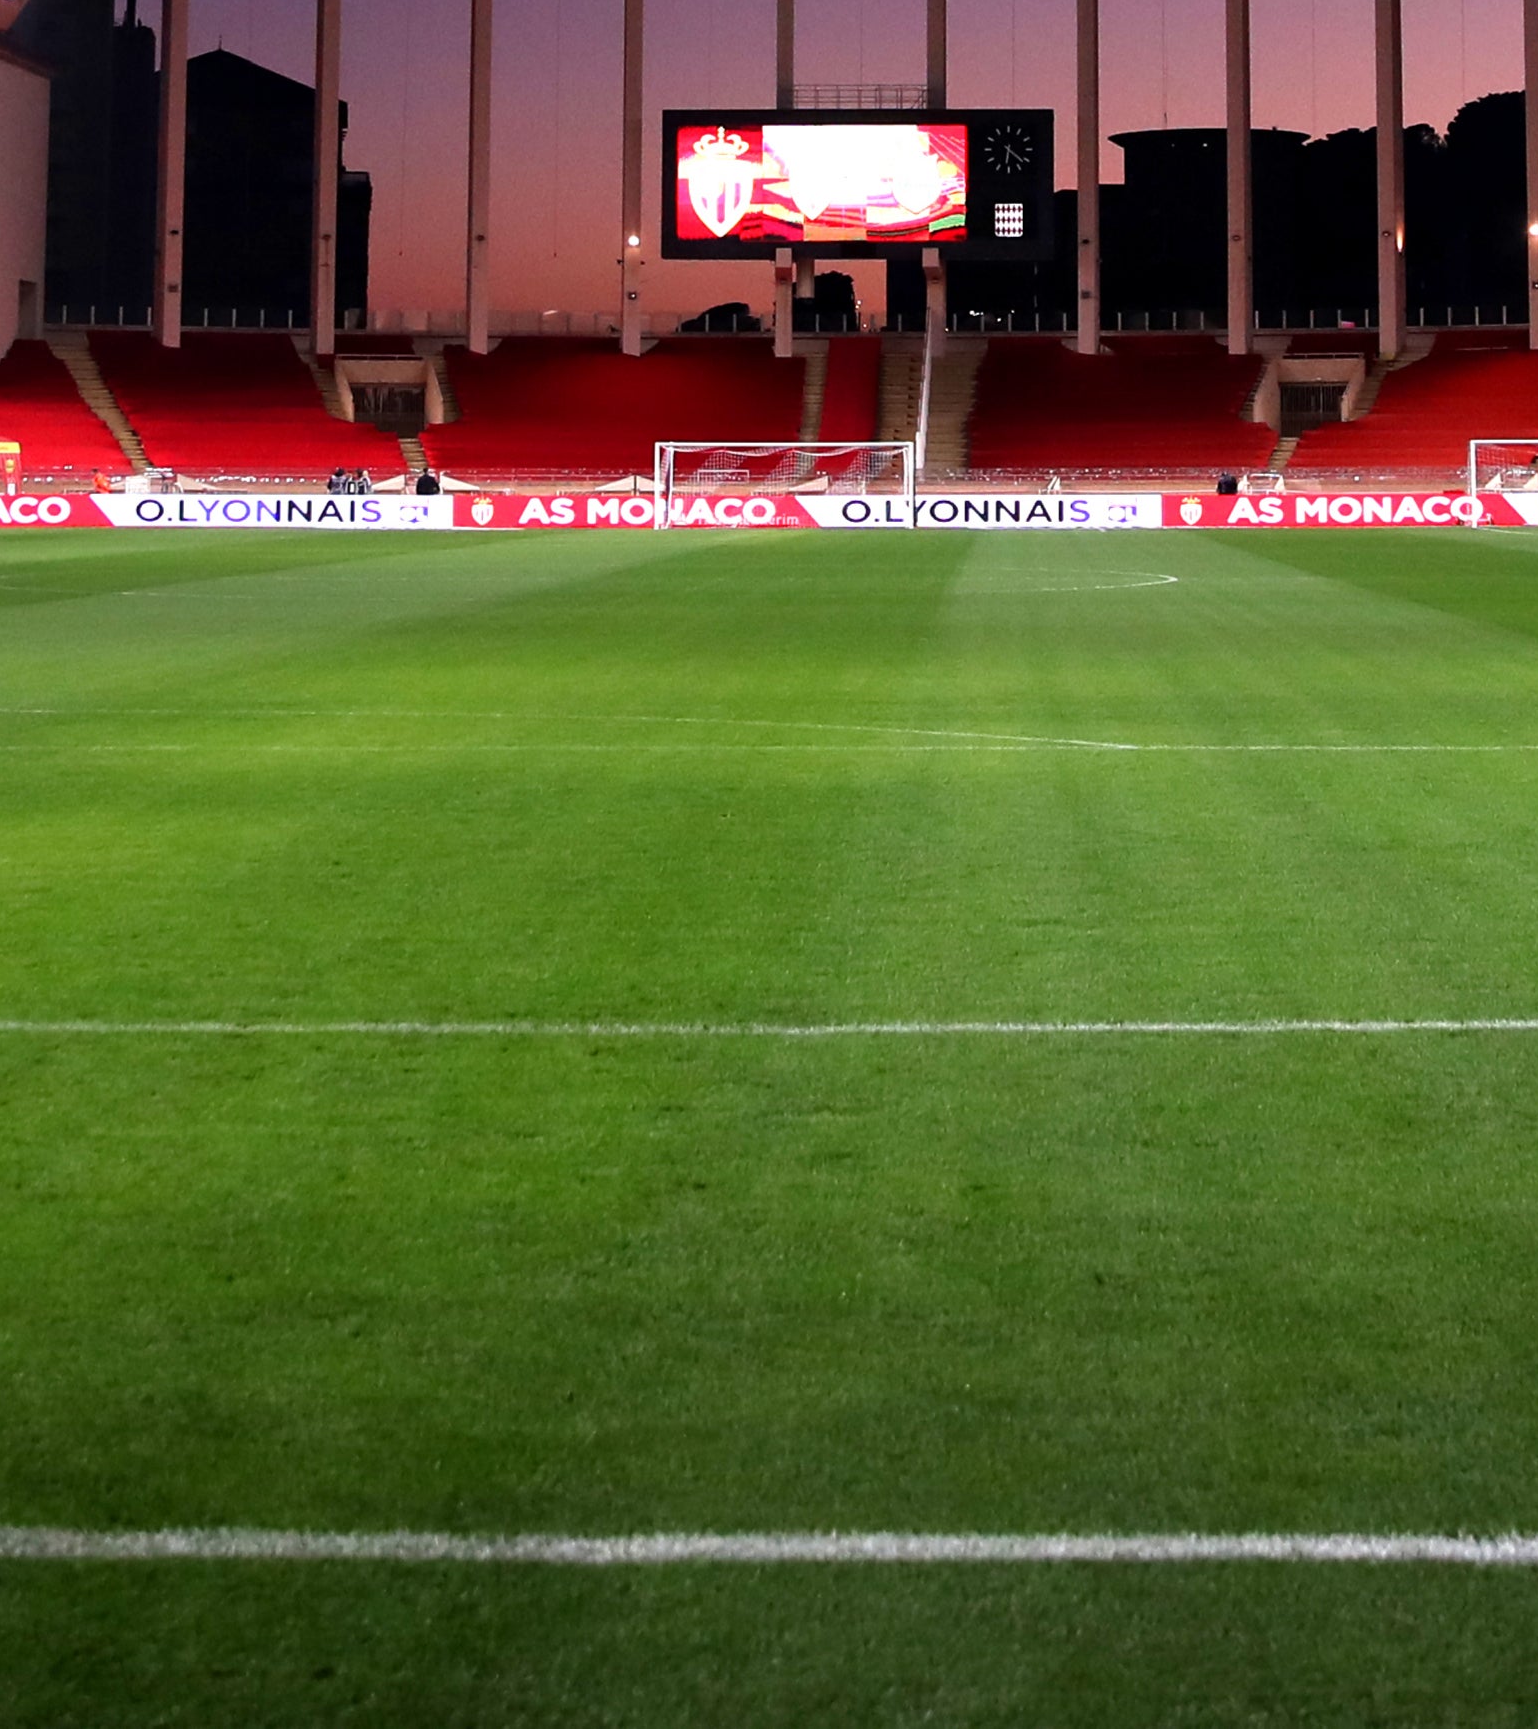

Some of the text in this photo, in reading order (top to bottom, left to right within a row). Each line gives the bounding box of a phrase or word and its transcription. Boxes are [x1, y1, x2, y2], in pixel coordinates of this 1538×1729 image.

[135, 499, 382, 523] O.LYONNAIS
[518, 497, 775, 525] AS MONACO
[841, 499, 1090, 524] O.LYONNAIS
[1227, 496, 1484, 524] AS MONACO
